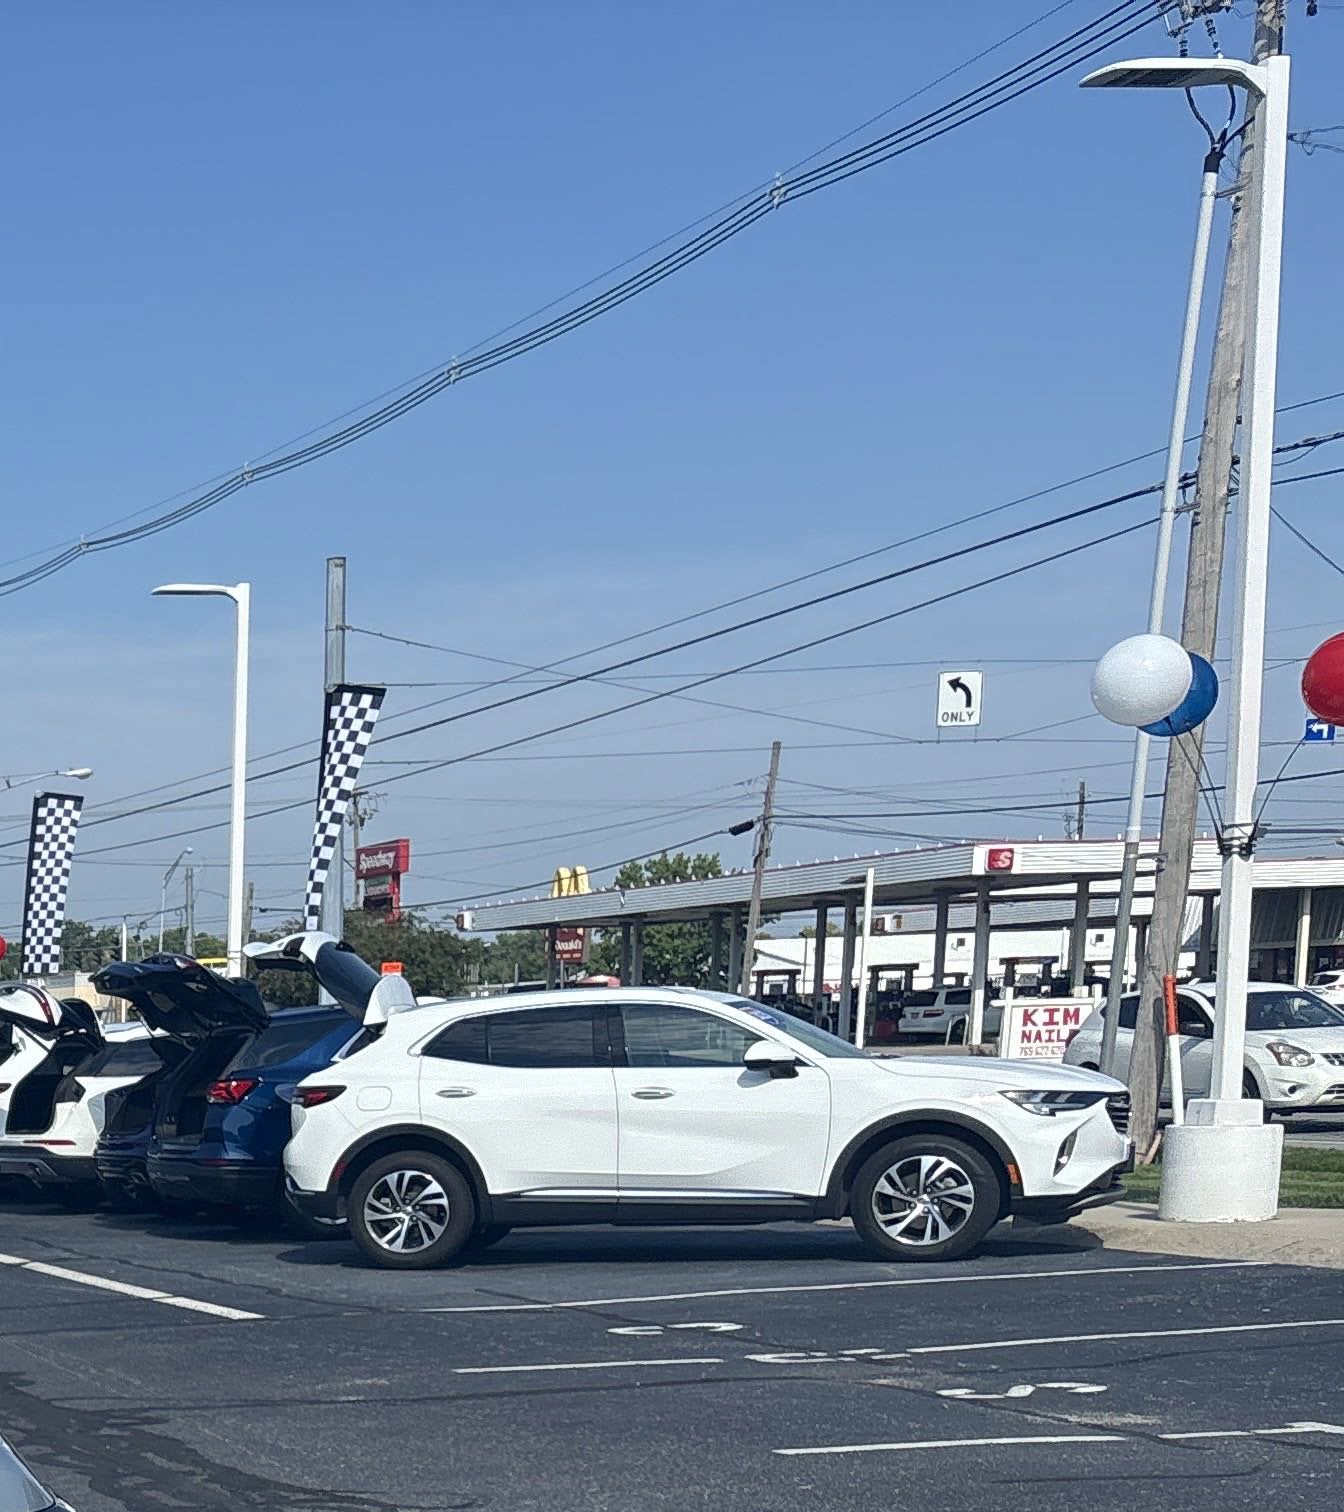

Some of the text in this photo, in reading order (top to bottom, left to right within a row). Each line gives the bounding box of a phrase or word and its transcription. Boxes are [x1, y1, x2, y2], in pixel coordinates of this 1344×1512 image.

[941, 711, 975, 723] ONLY
[1022, 1007, 1080, 1026] KIM
[1021, 1029, 1068, 1043] NAIL
